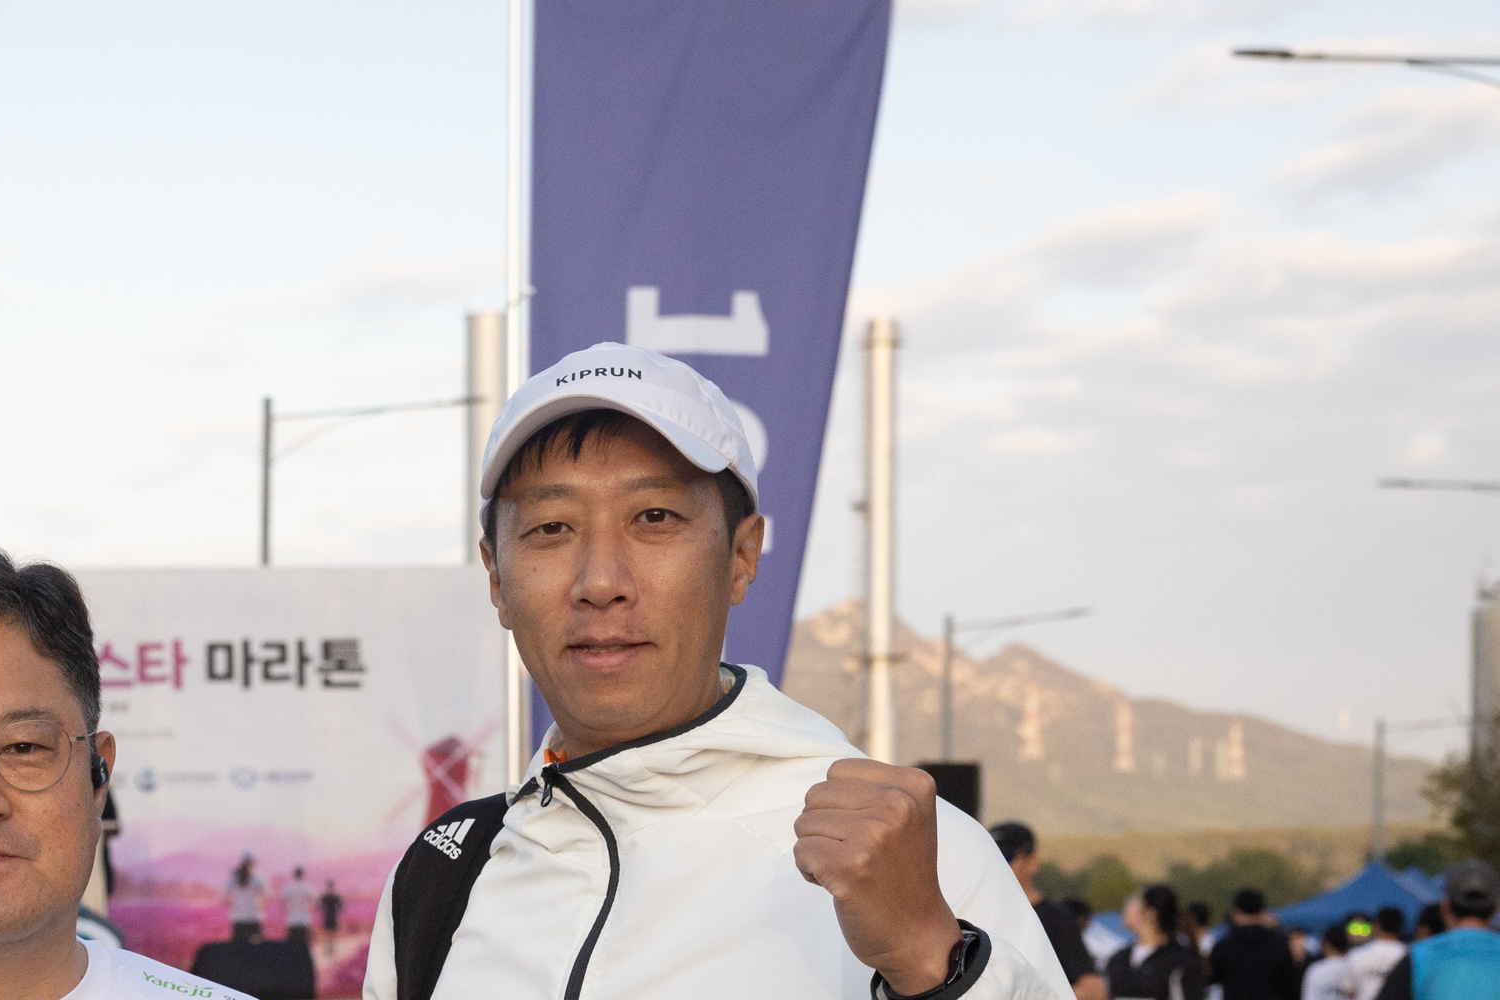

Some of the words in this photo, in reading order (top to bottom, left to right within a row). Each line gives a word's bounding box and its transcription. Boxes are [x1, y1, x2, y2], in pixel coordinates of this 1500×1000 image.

[556, 367, 642, 387] KIPRUN
[99, 638, 189, 690] 스타
[206, 637, 366, 690] 마라톤
[423, 829, 462, 860] adidas
[142, 971, 214, 998] Yangju
